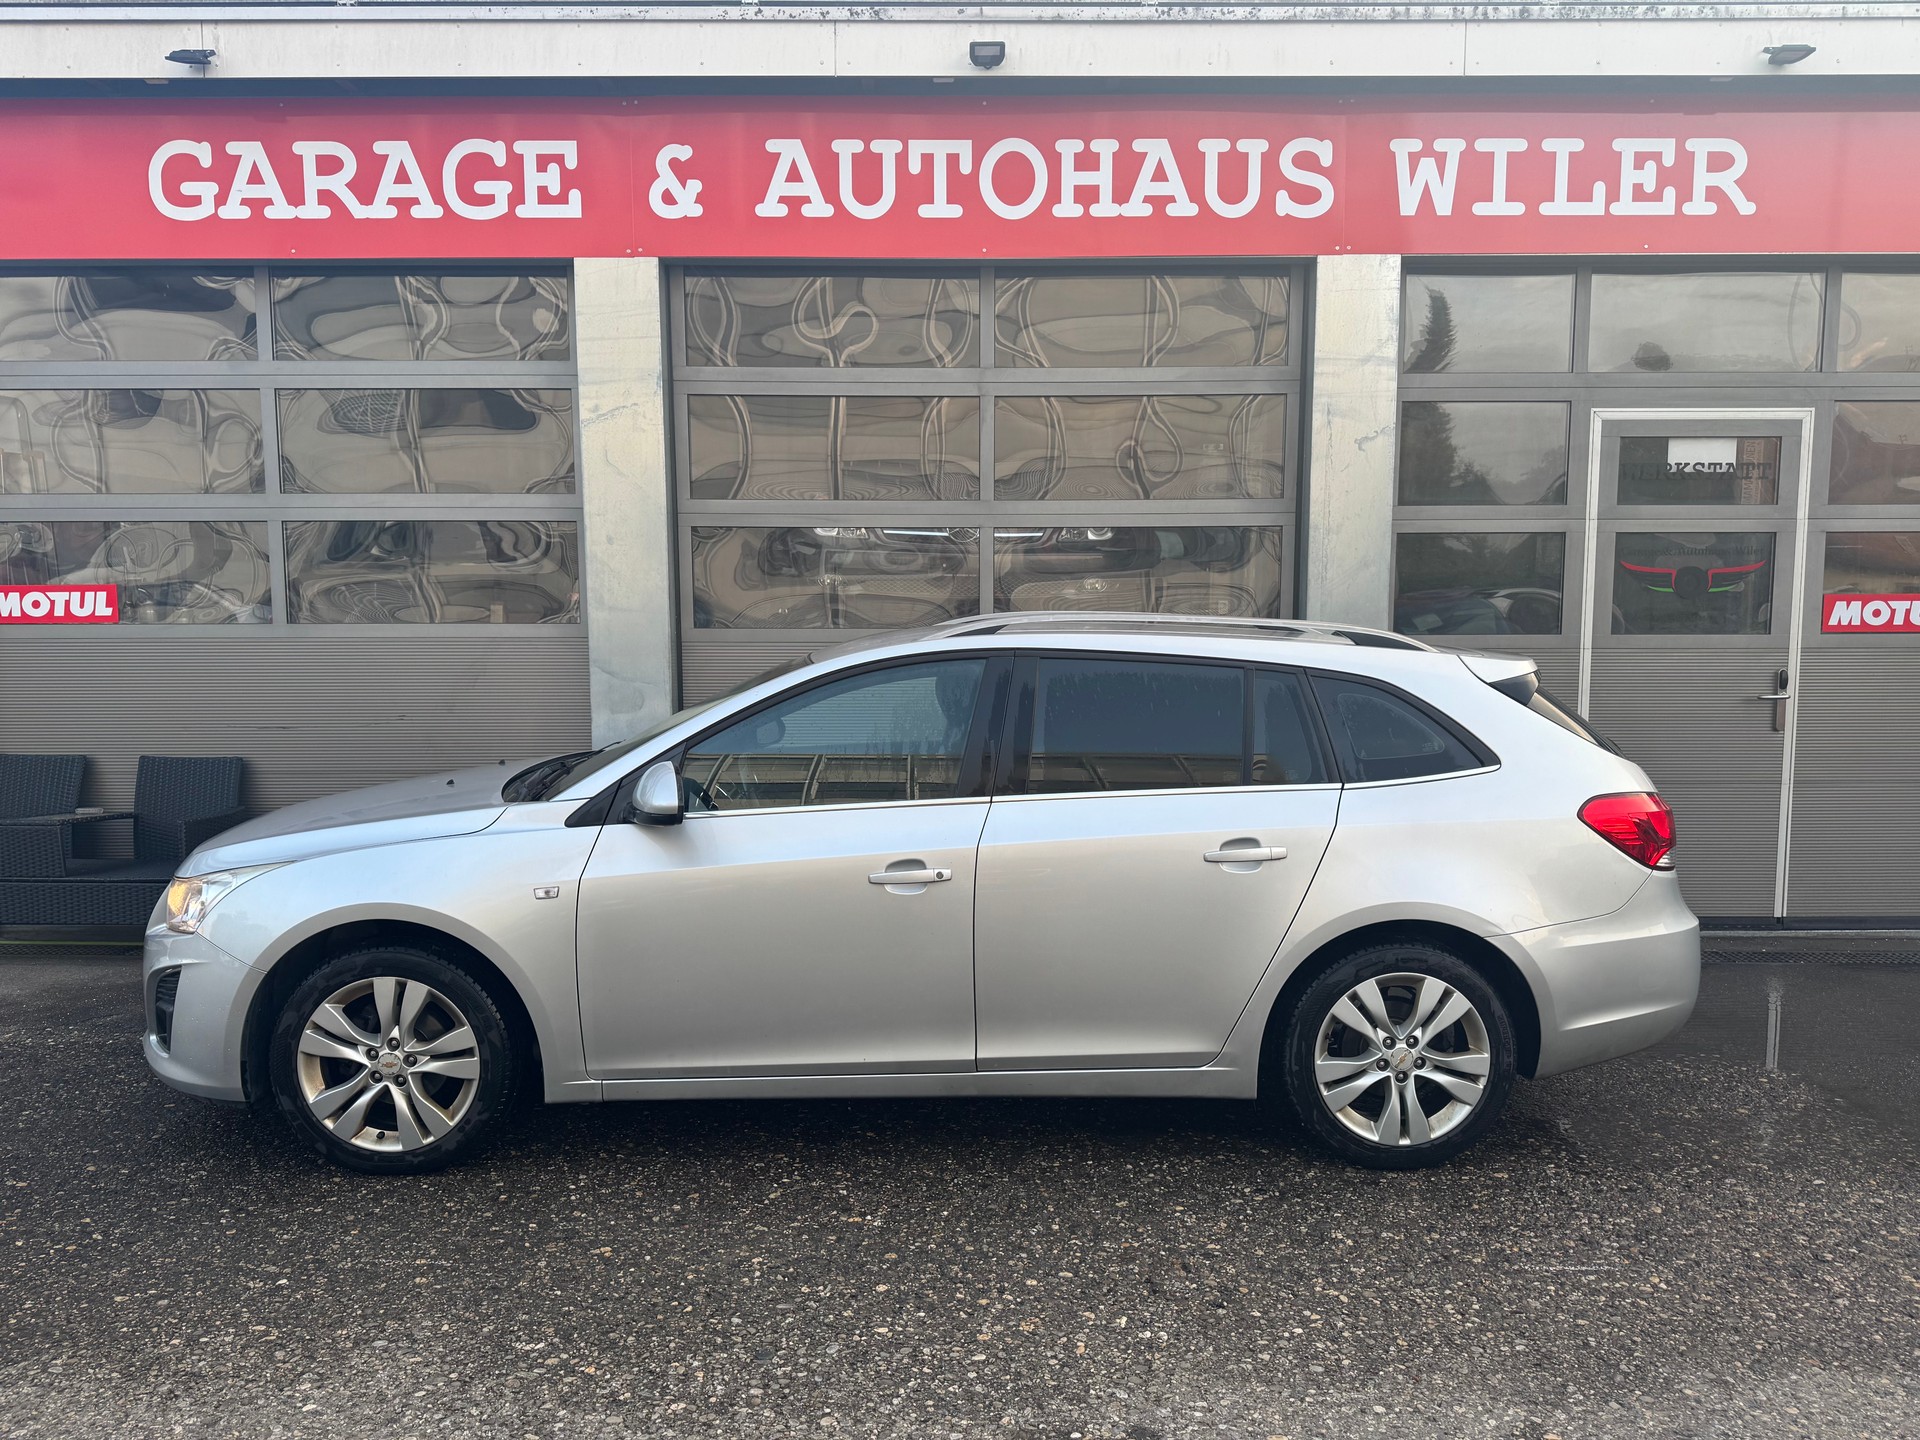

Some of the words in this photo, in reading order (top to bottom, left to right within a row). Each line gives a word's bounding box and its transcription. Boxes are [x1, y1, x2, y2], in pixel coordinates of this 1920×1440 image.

[149, 138, 582, 221] GARAGE
[649, 143, 703, 219] &
[755, 136, 1334, 219] AUTOHAUS
[1390, 137, 1756, 218] WILER
[1620, 462, 1772, 480] WERKSTATT
[0, 591, 113, 617] MOTUL
